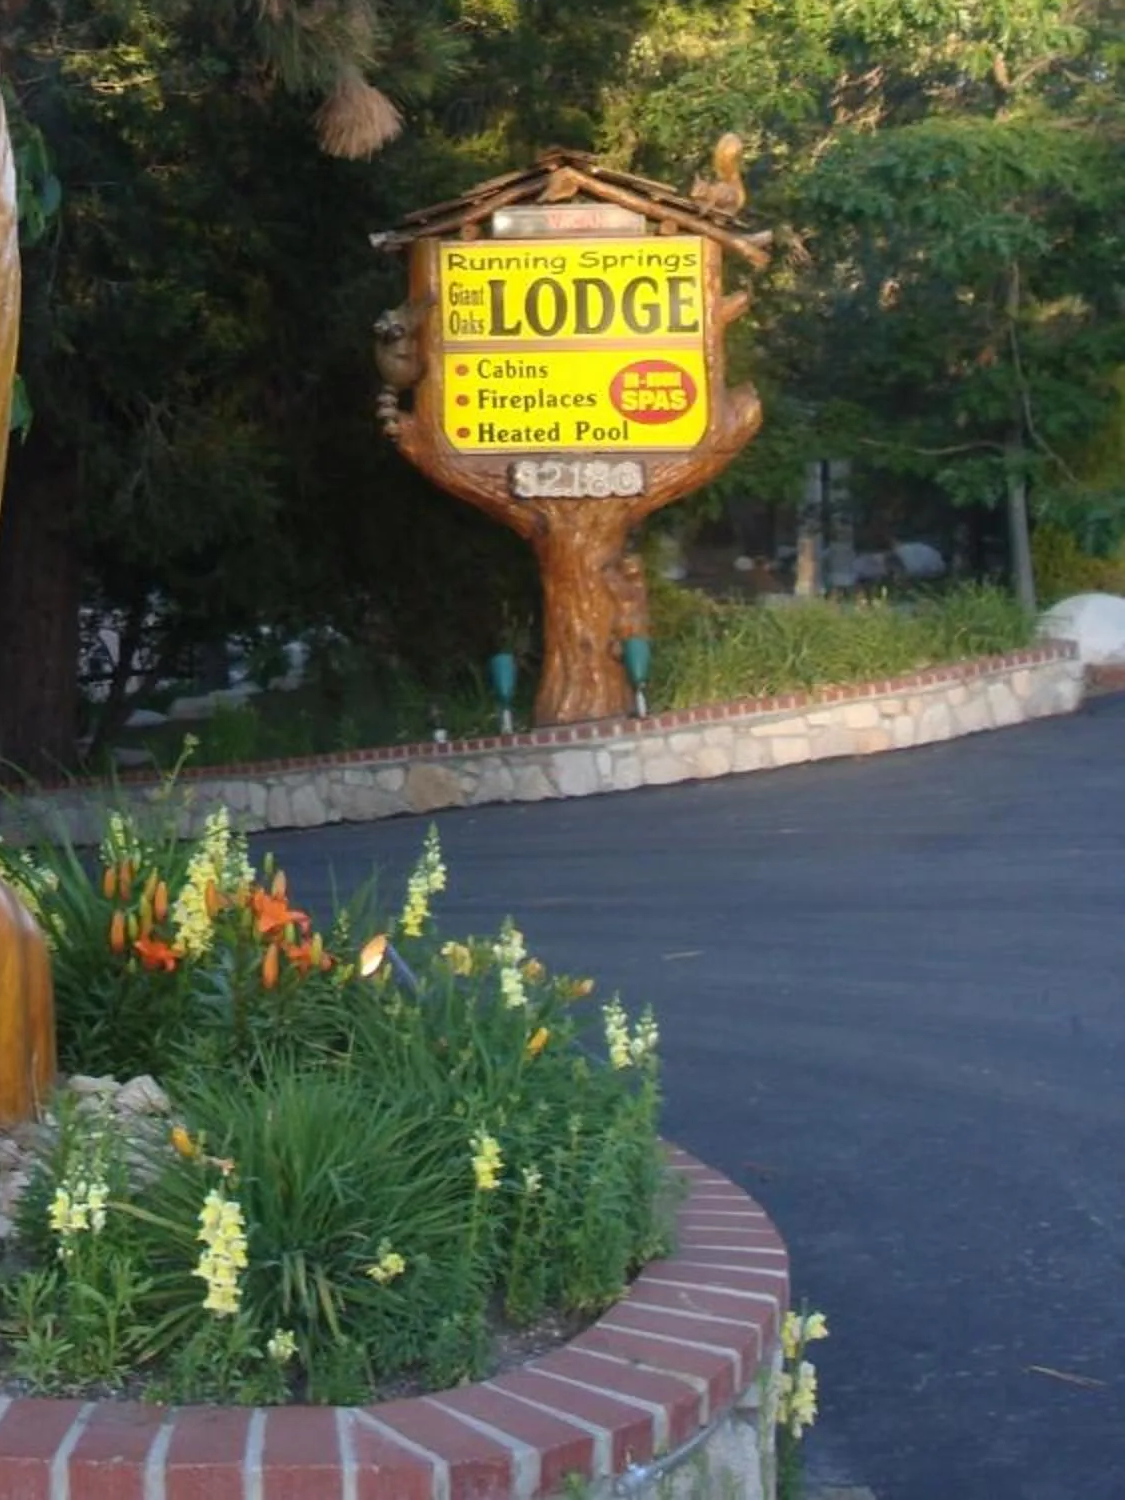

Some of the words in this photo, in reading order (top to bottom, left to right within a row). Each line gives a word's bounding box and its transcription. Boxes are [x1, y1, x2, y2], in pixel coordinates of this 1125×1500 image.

[448, 253, 566, 274] Running
[579, 251, 698, 273] Springs
[448, 282, 484, 306] Giant
[488, 276, 700, 337] LODGE
[449, 312, 484, 336] Oaks
[477, 359, 549, 379] Cabins
[478, 389, 598, 412] Fireplaces
[621, 390, 687, 411] SPAS
[478, 423, 561, 444] Heated
[576, 421, 629, 441] Pool
